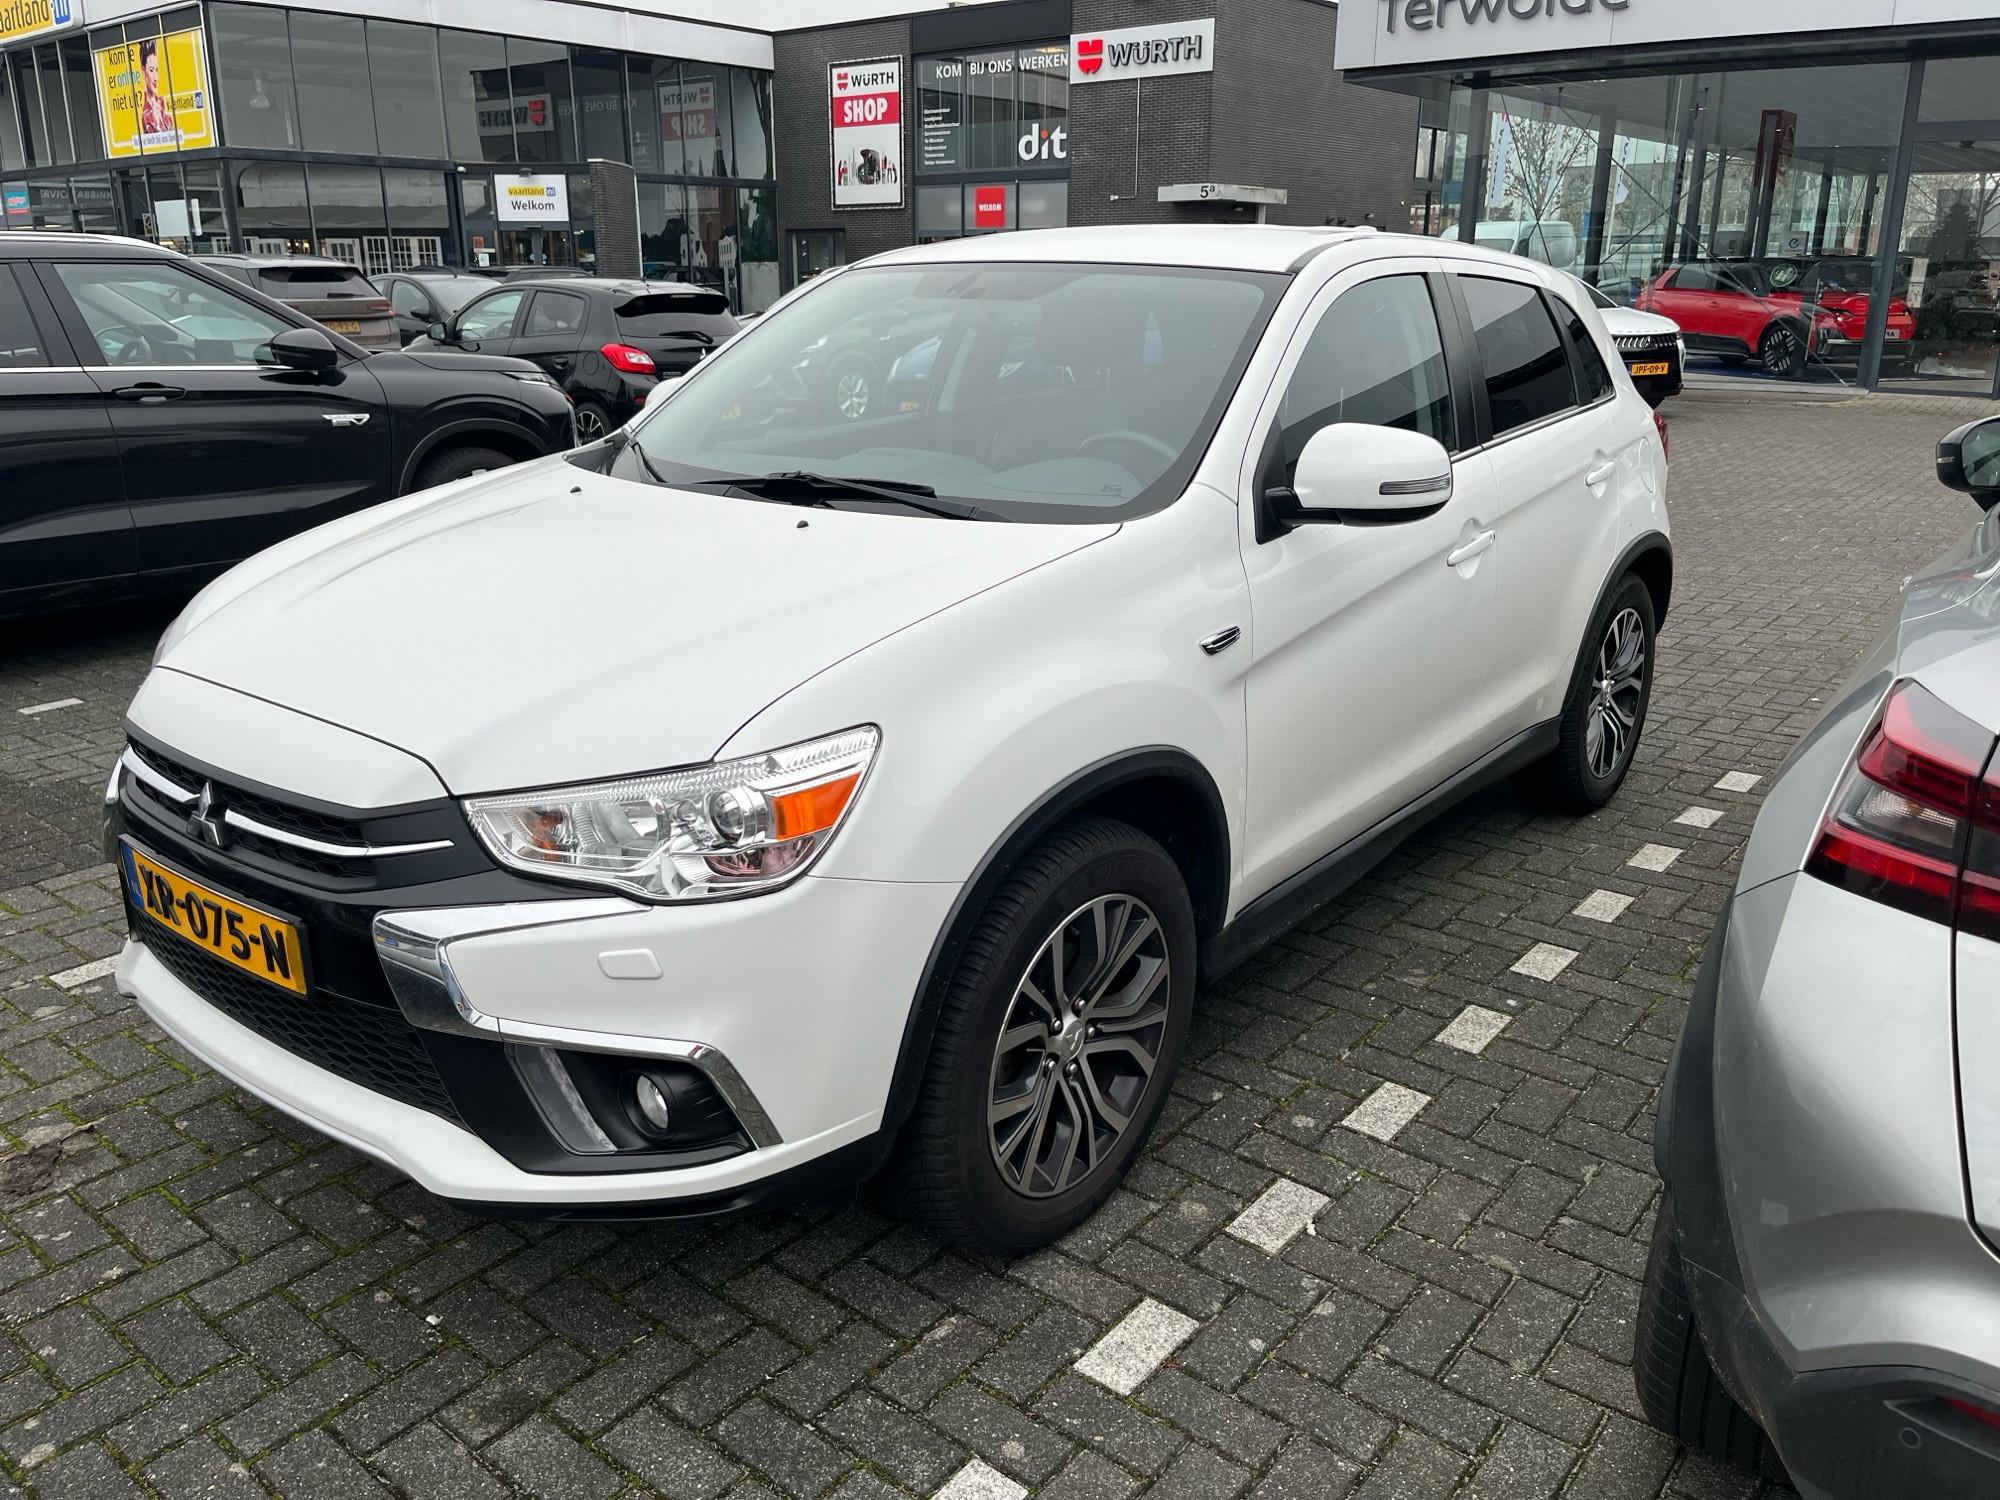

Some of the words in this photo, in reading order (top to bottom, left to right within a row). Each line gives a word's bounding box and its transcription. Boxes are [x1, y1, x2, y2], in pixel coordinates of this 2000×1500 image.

[108, 49, 126, 66] kom
[936, 63, 962, 79] KOM
[970, 62, 985, 75] BIJ
[988, 59, 1012, 73] ONS
[1019, 53, 1069, 71] WERKEN
[109, 75, 117, 88] er
[113, 93, 128, 111] niet
[843, 97, 888, 124] SHOP
[1018, 123, 1067, 160] dit
[508, 187, 545, 196] vaartland
[512, 200, 554, 210] Welkom
[979, 203, 1002, 212] WELKOM
[138, 863, 291, 980] XR-075-N
